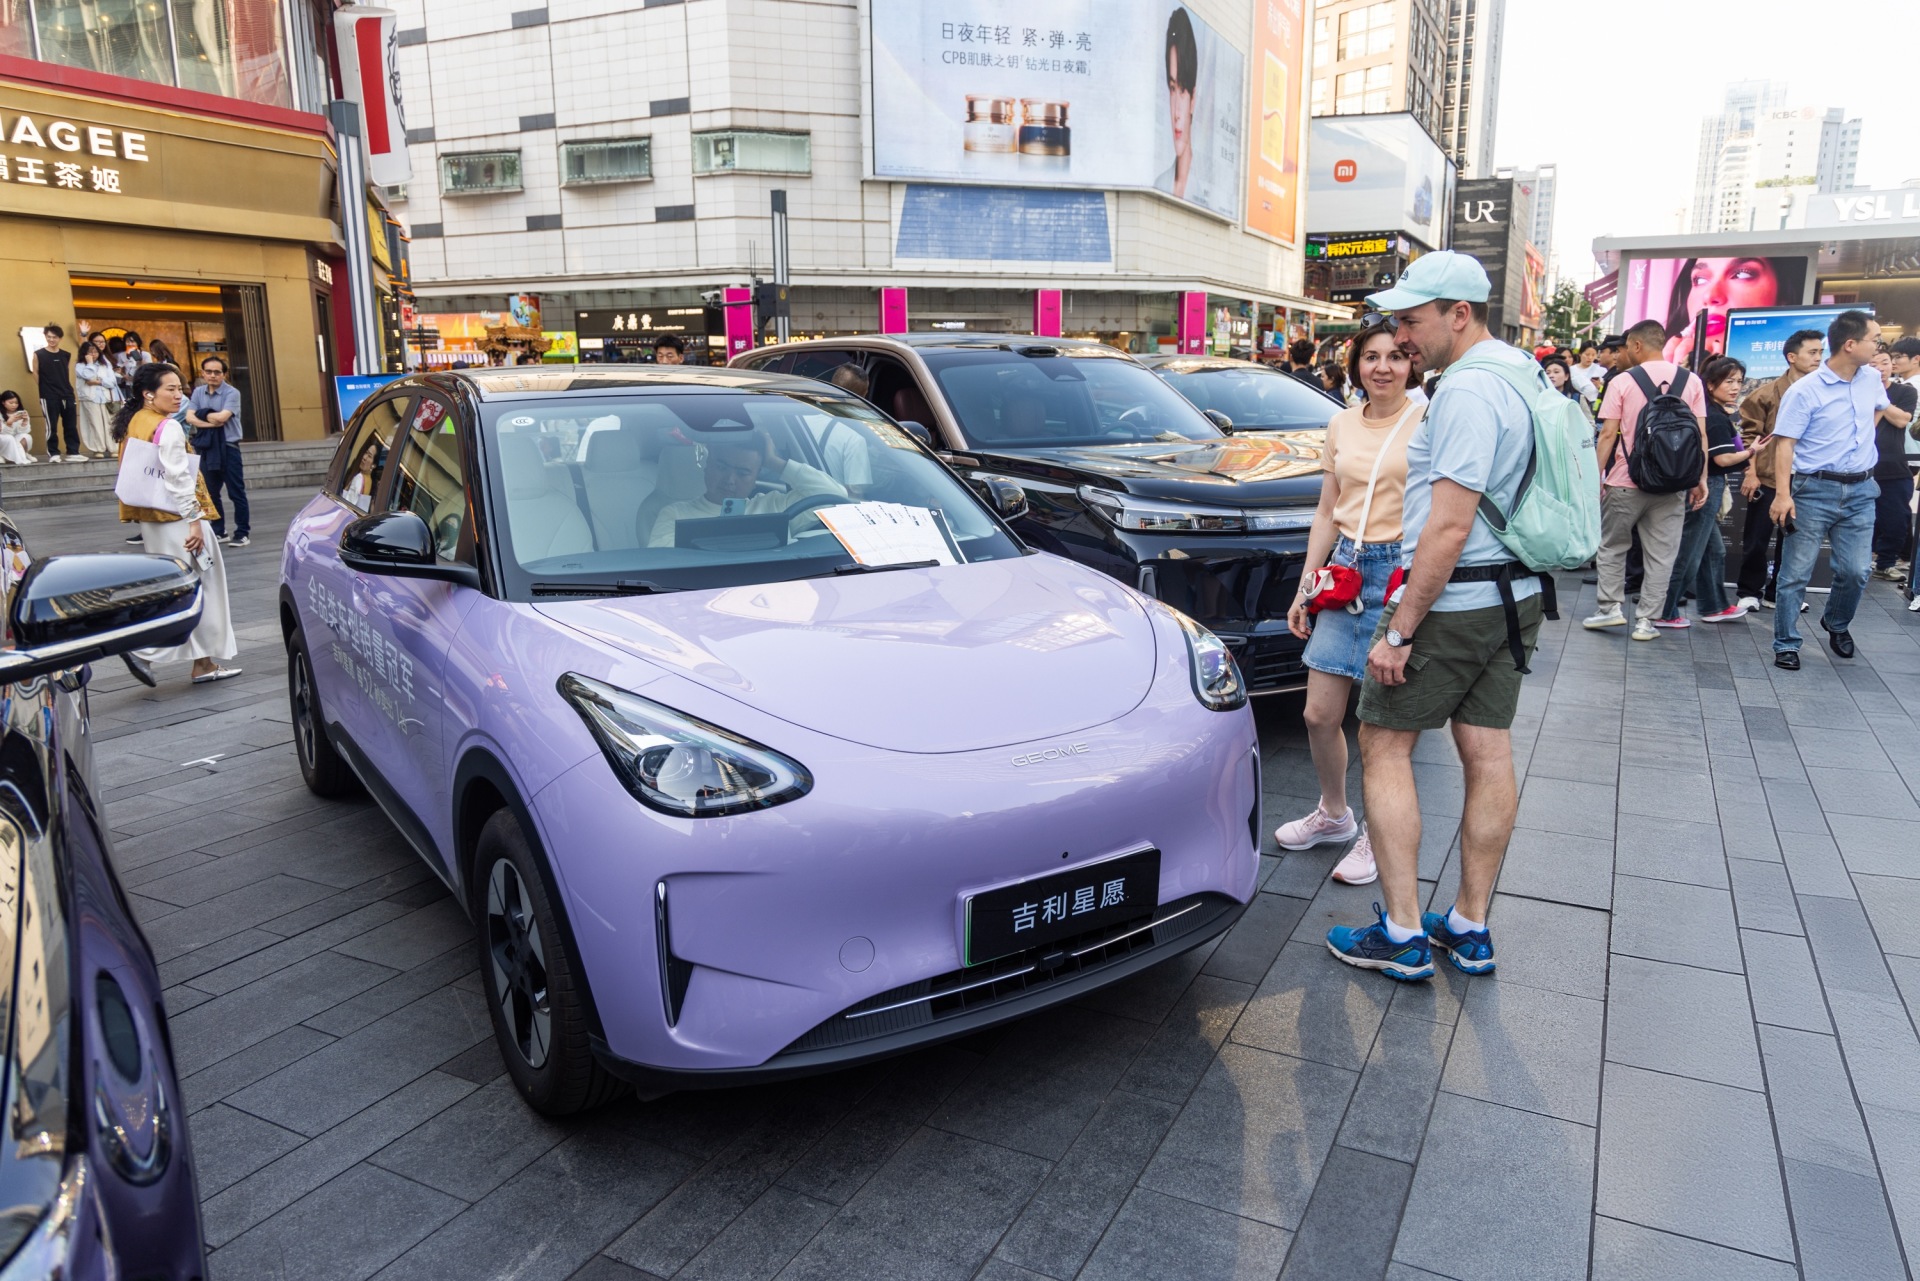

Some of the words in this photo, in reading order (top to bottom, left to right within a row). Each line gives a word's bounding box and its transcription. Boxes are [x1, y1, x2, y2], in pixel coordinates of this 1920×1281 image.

[942, 22, 1011, 45] 日夜年轻
[1772, 110, 1798, 120] ICBC
[0, 113, 149, 162] AGEE
[1463, 200, 1499, 224] UR
[1833, 195, 1892, 222] YSL
[1902, 193, 1920, 218] L
[1011, 742, 1091, 767] GEOME
[1012, 877, 1126, 933] 吉利星愿
